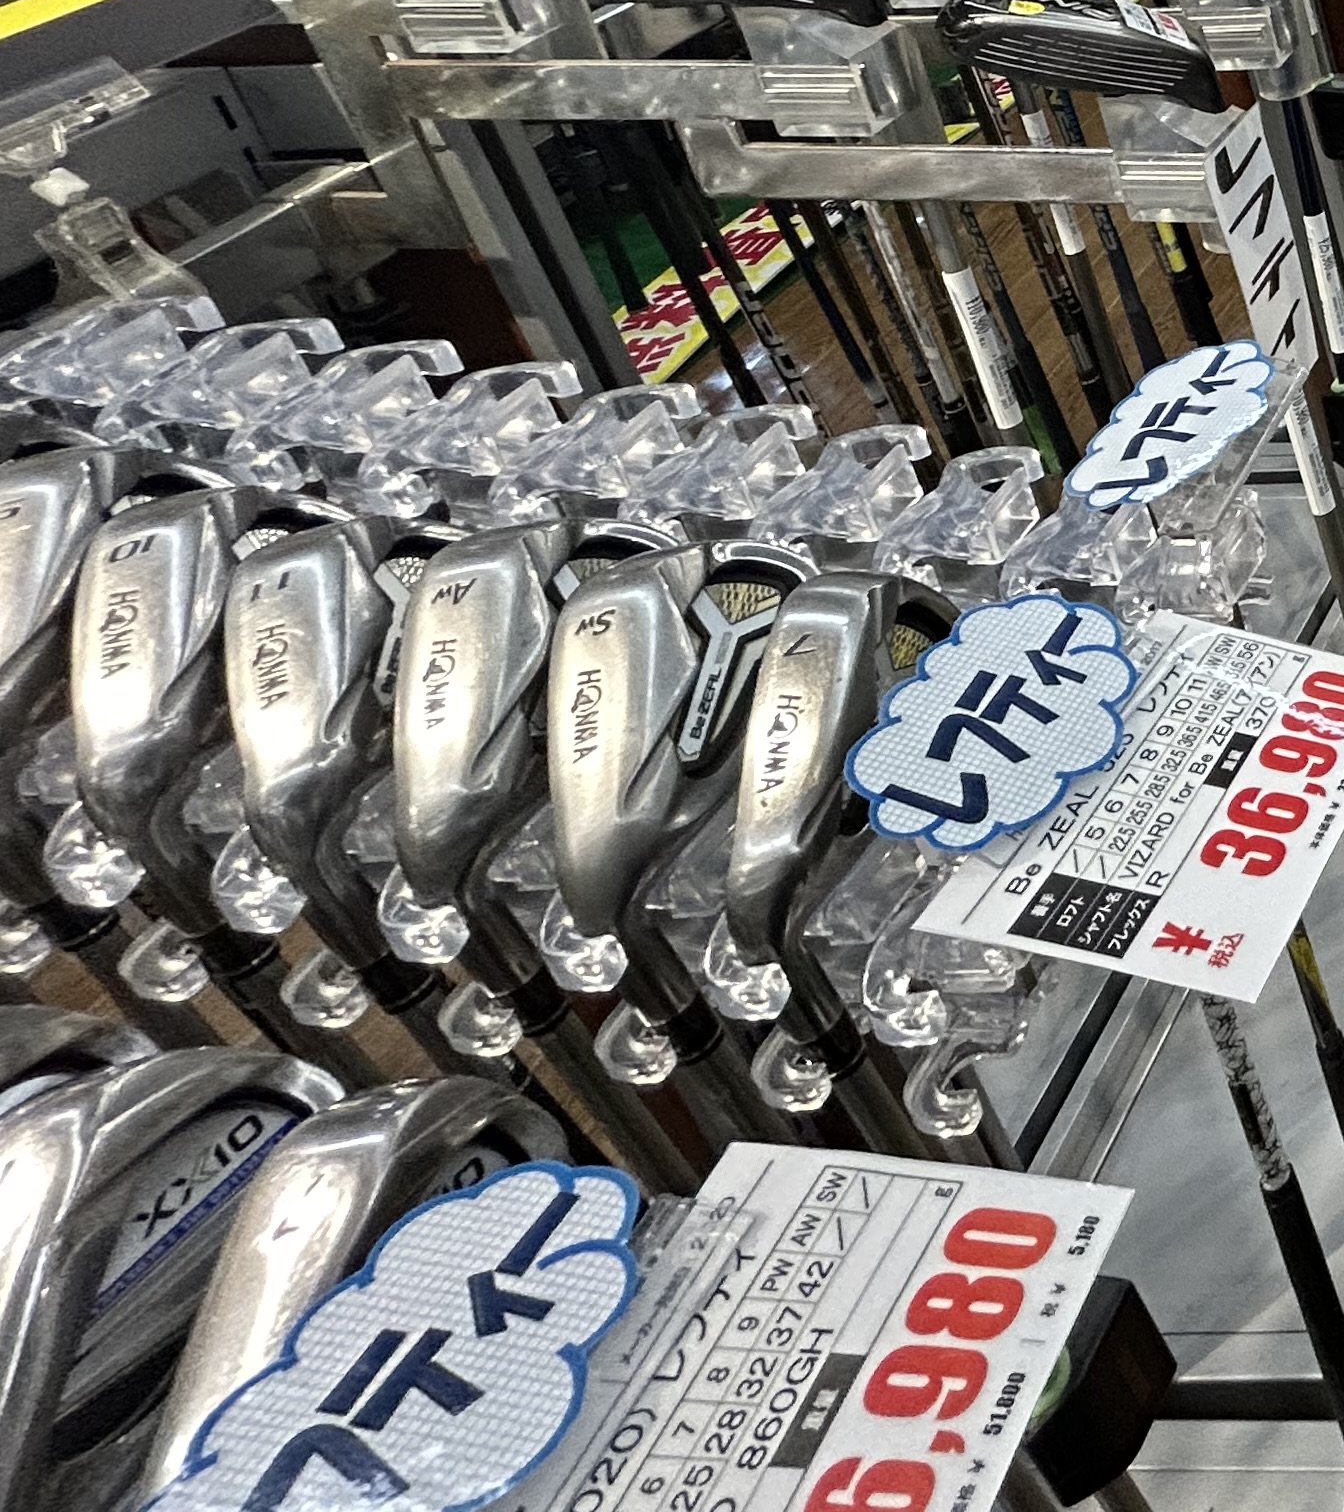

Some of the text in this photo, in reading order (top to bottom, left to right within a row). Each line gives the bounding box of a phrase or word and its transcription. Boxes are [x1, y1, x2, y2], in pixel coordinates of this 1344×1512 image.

[99, 589, 139, 680] HONMA
[251, 622, 291, 711] HONMA
[421, 638, 458, 731] HONMA
[569, 668, 603, 765] HONMA
[755, 693, 804, 795] HONMA
[881, 612, 1087, 824] レフティー
[1084, 825, 1106, 841] 5
[1104, 799, 1124, 814] 6
[1120, 773, 1140, 785] 7
[1139, 748, 1159, 762] 8
[1156, 724, 1175, 737] 9
[1170, 698, 1193, 716] 10
[1187, 678, 1207, 692] 11
[1214, 636, 1237, 655] SW
[1004, 863, 1042, 896] Be
[1037, 785, 1100, 851] ZEAL
[1055, 896, 1085, 927] ロフト
[1236, 642, 1260, 661] 56
[1107, 899, 1151, 950] フレックス
[1145, 870, 1170, 888] R
[1245, 696, 1276, 730] 370
[1077, 892, 1123, 945] シャフト名
[1118, 812, 1175, 879] VIZARD
[1169, 781, 1195, 805] for
[1187, 753, 1214, 776] Be
[1153, 920, 1212, 956] ¥
[1207, 932, 1245, 969] 税込
[641, 1172, 847, 1495] 6 7 8 9 PW AW SW
[671, 1260, 835, 1512] 25 28 32 37 42
[735, 1327, 834, 1471] 860GH
